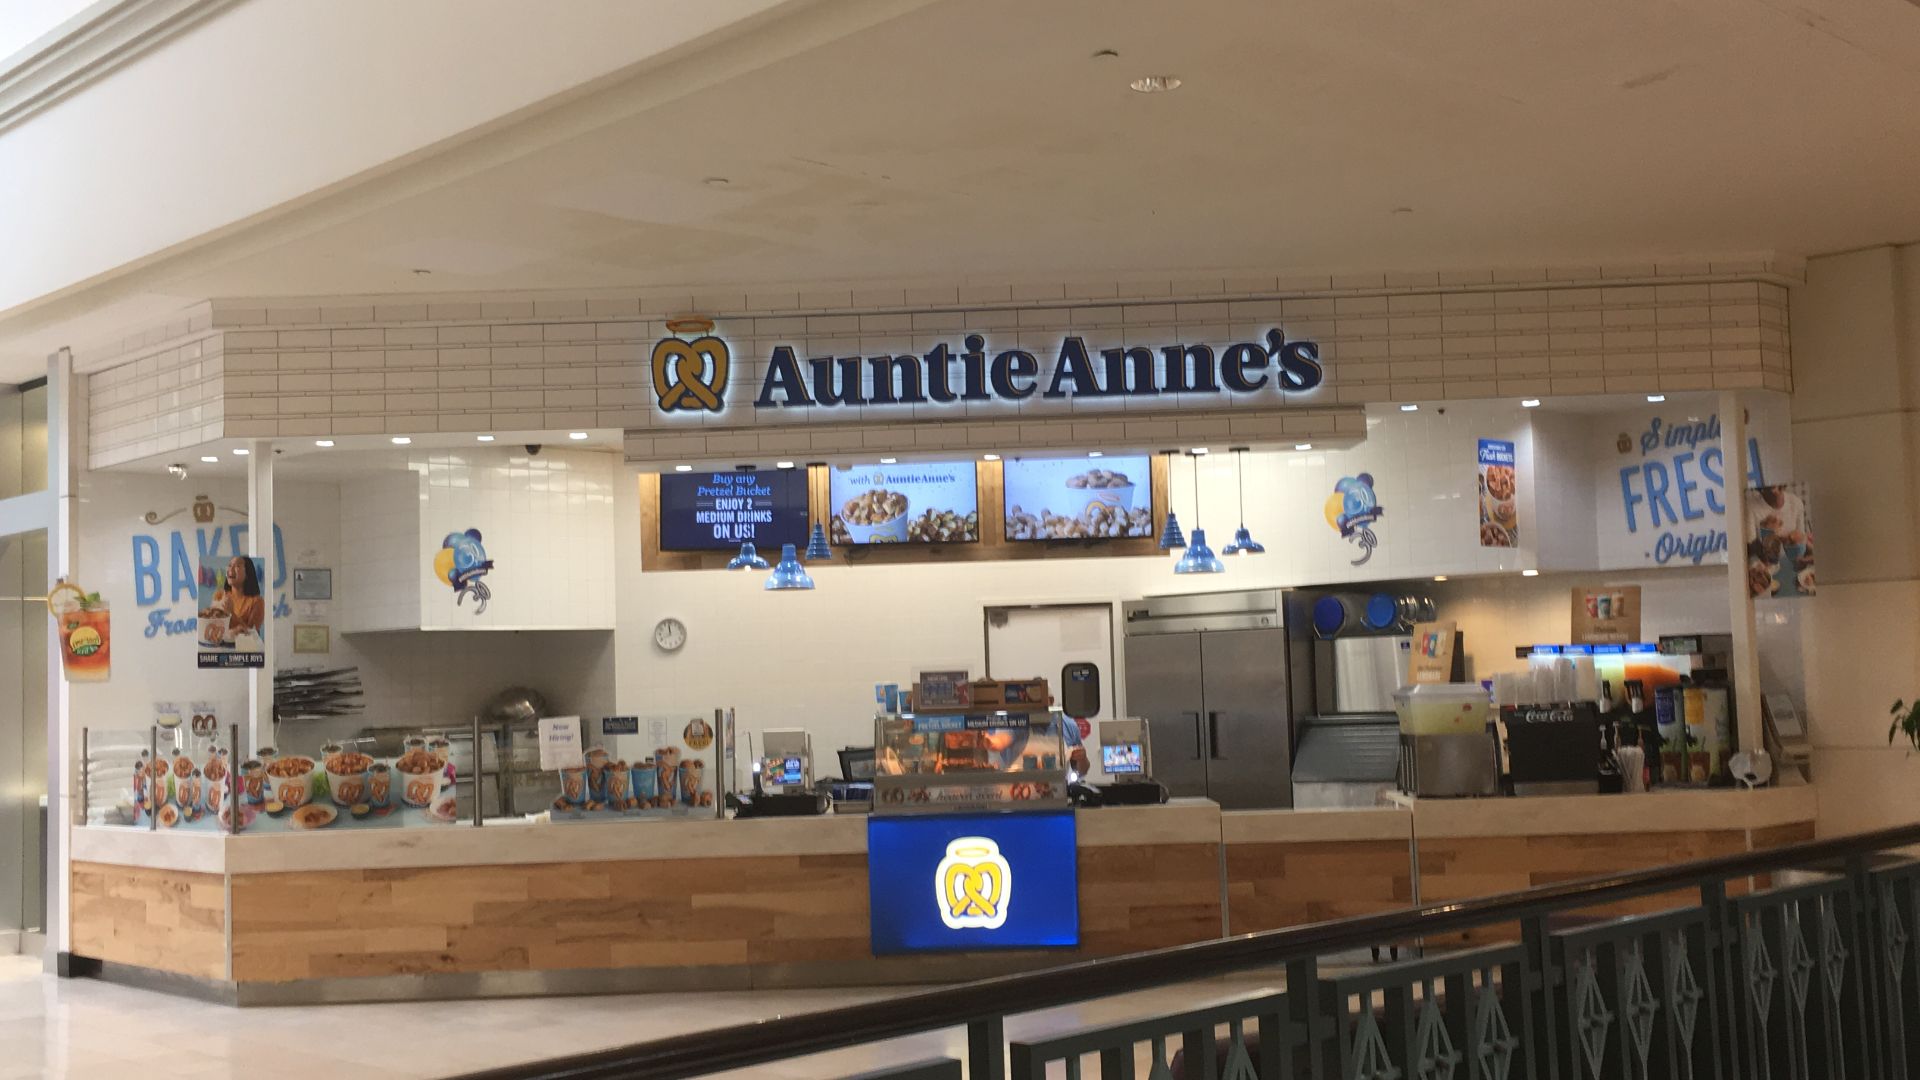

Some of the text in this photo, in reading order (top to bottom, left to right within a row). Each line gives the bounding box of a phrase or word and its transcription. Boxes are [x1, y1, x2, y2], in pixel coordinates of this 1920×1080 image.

[754, 328, 1323, 407] Auntie Anne's
[1640, 413, 1720, 456] Simpl
[713, 474, 756, 485] Buy any
[850, 472, 956, 486] with Auntie Anne's
[697, 484, 772, 497] Pretzel Bucket
[715, 498, 753, 510] ENJOY 2
[696, 510, 772, 523] MEDIUM DRINKS
[713, 523, 756, 539] ON US!
[199, 655, 219, 663] SHARE
